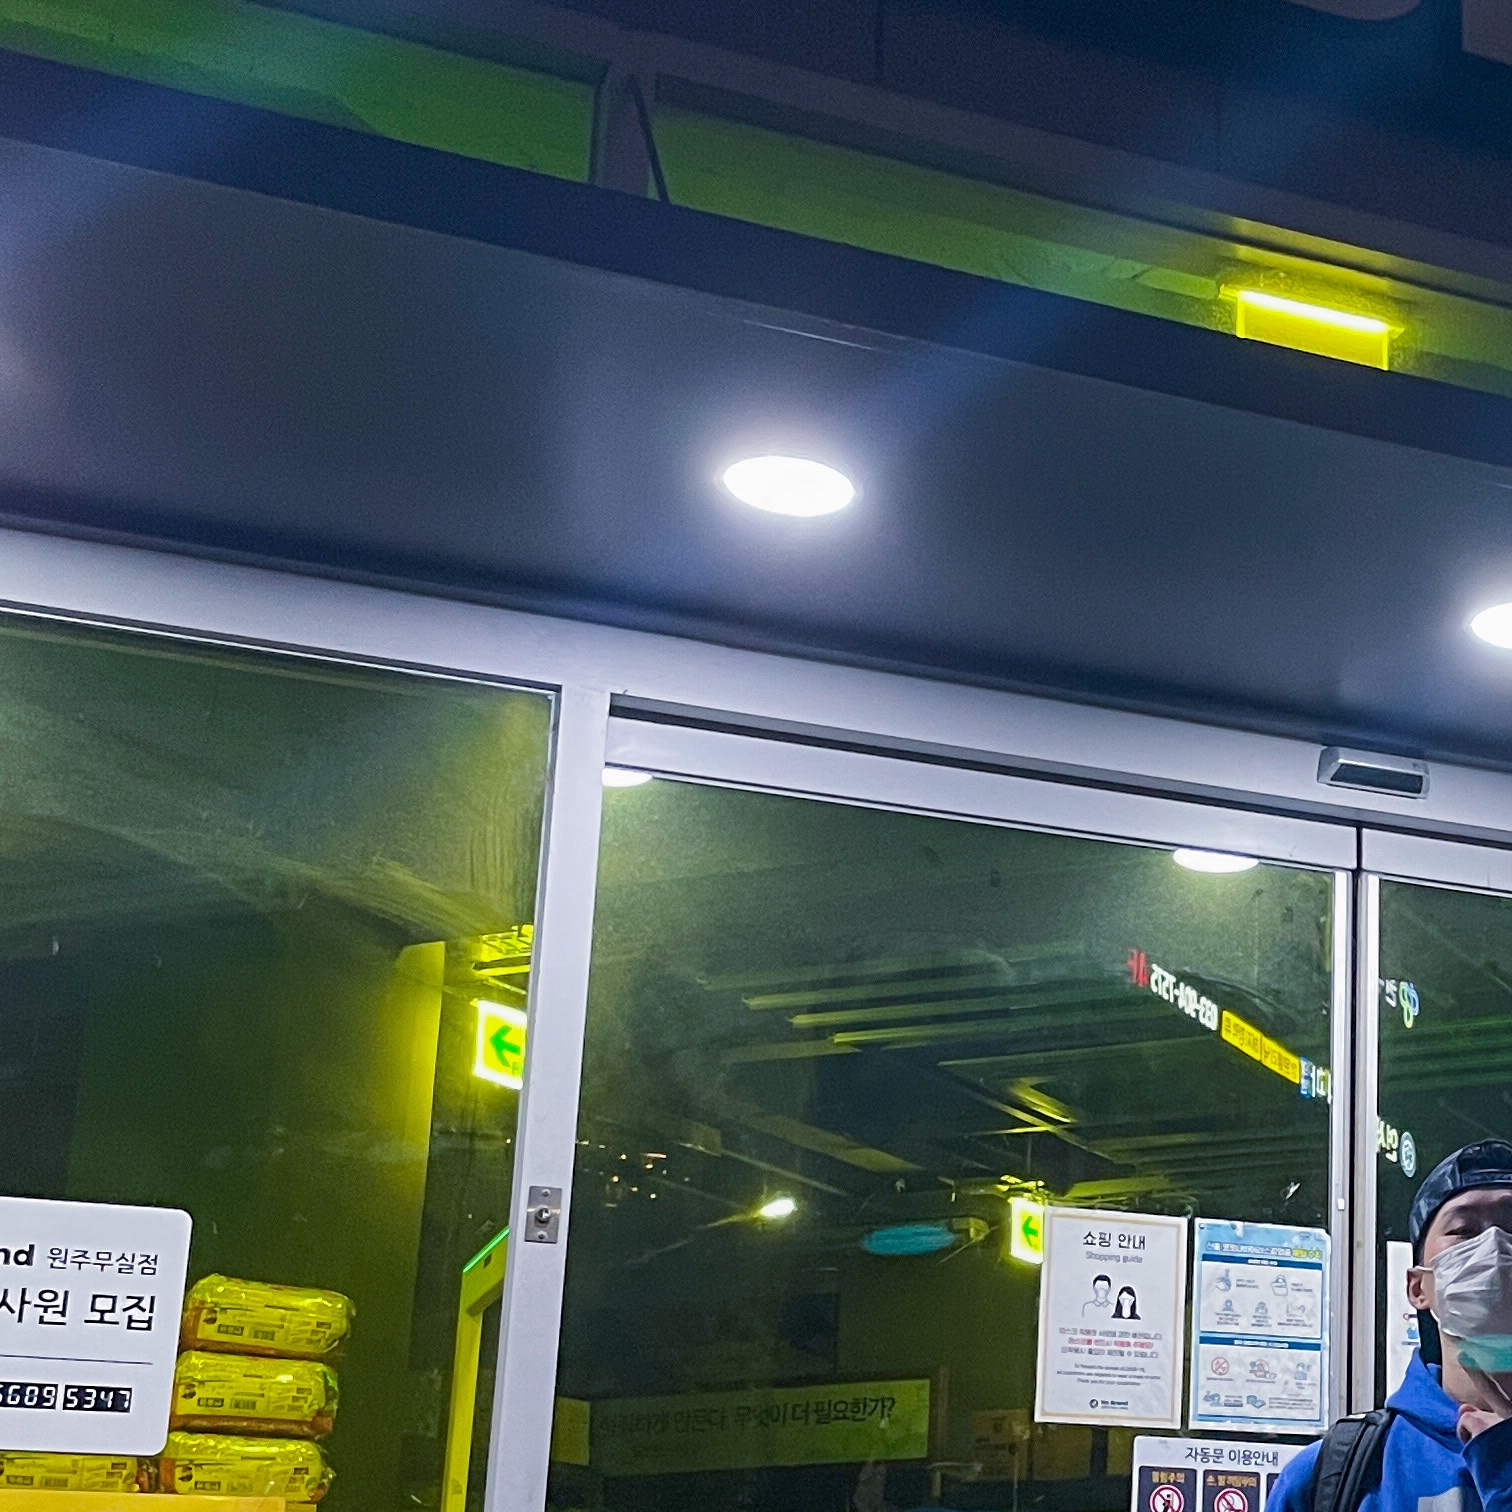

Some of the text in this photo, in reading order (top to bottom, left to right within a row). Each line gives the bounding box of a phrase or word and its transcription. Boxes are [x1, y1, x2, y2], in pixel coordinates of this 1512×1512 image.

[1083, 1231, 1146, 1250] 쇼핑 안내
[47, 1248, 159, 1276] 원주무실점
[1086, 1251, 1121, 1263] Shopping
[84, 1294, 156, 1332] 모집
[65, 1387, 131, 1409] 5347
[813, 1395, 896, 1425] 필요한가?
[1185, 1447, 1279, 1467] 자동문 이용안내
